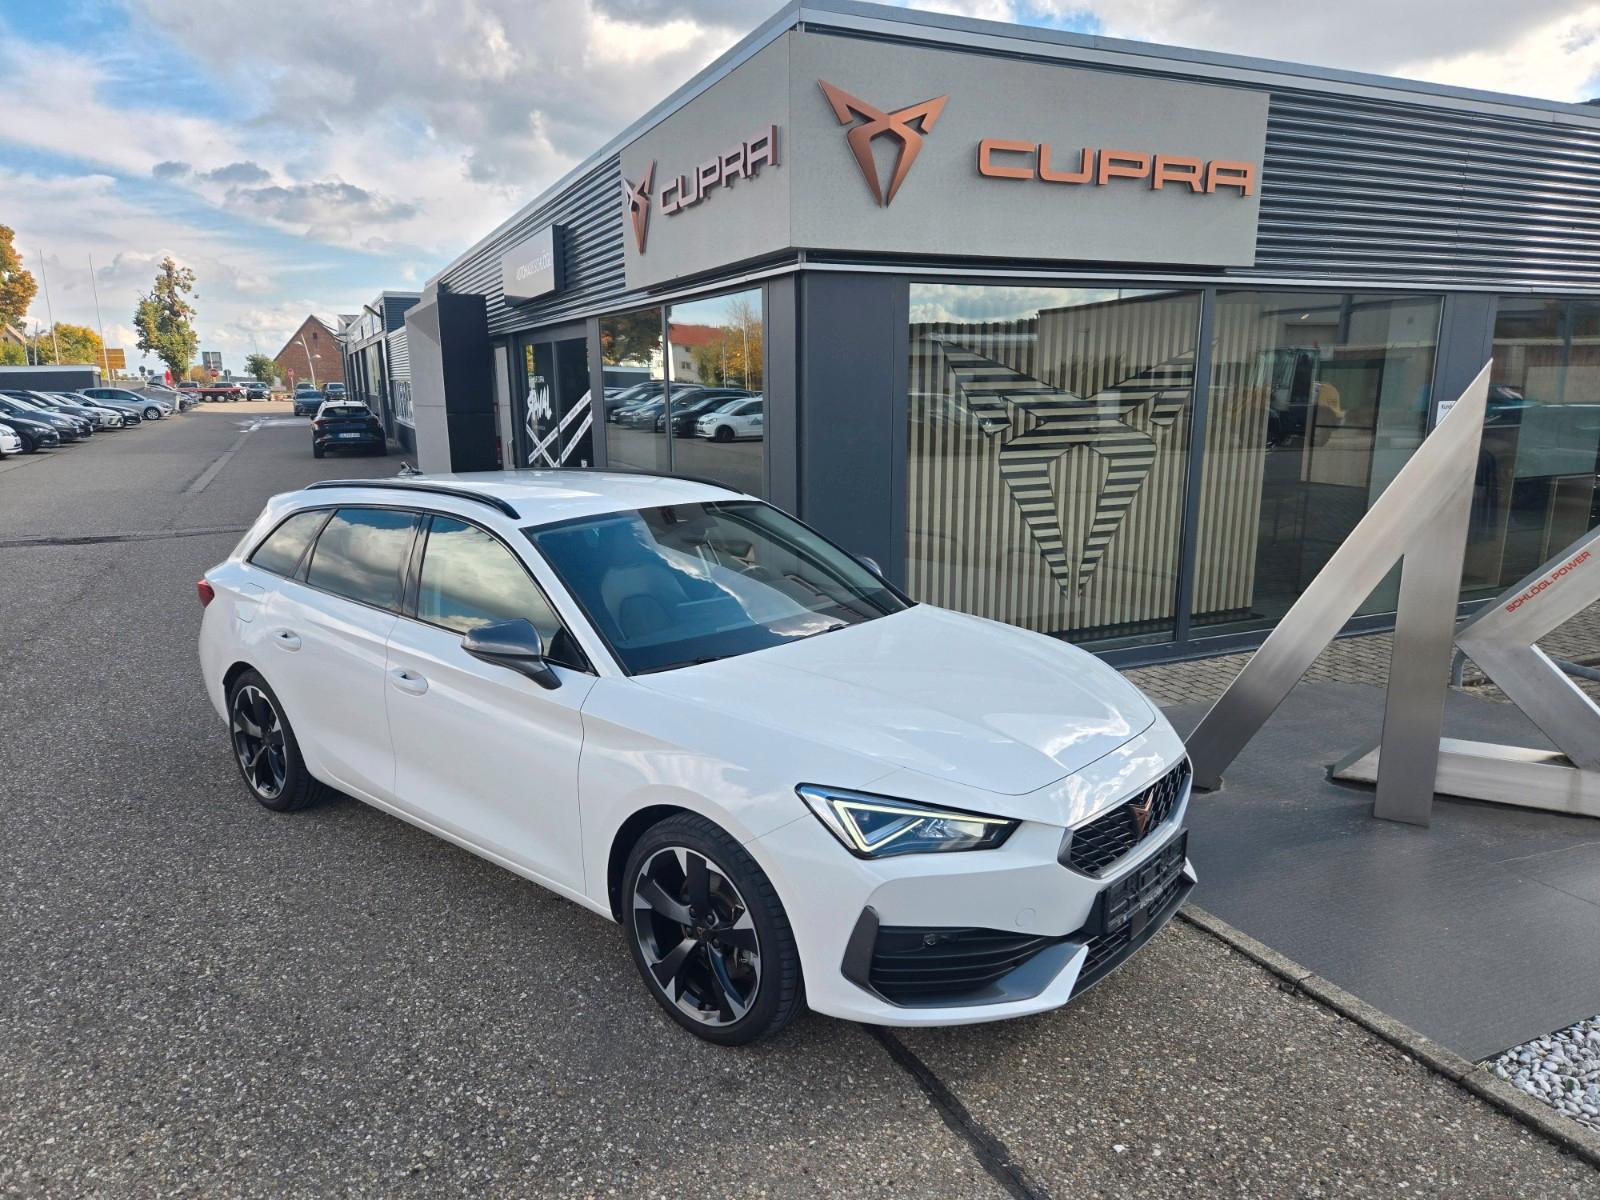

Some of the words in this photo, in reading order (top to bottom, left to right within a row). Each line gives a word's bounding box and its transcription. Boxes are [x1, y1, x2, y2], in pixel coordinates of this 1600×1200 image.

[660, 124, 778, 215] CUPRA
[977, 138, 1255, 197] CUPRA
[1505, 579, 1553, 613] SCHLÖGL
[1551, 551, 1592, 581] POWER
